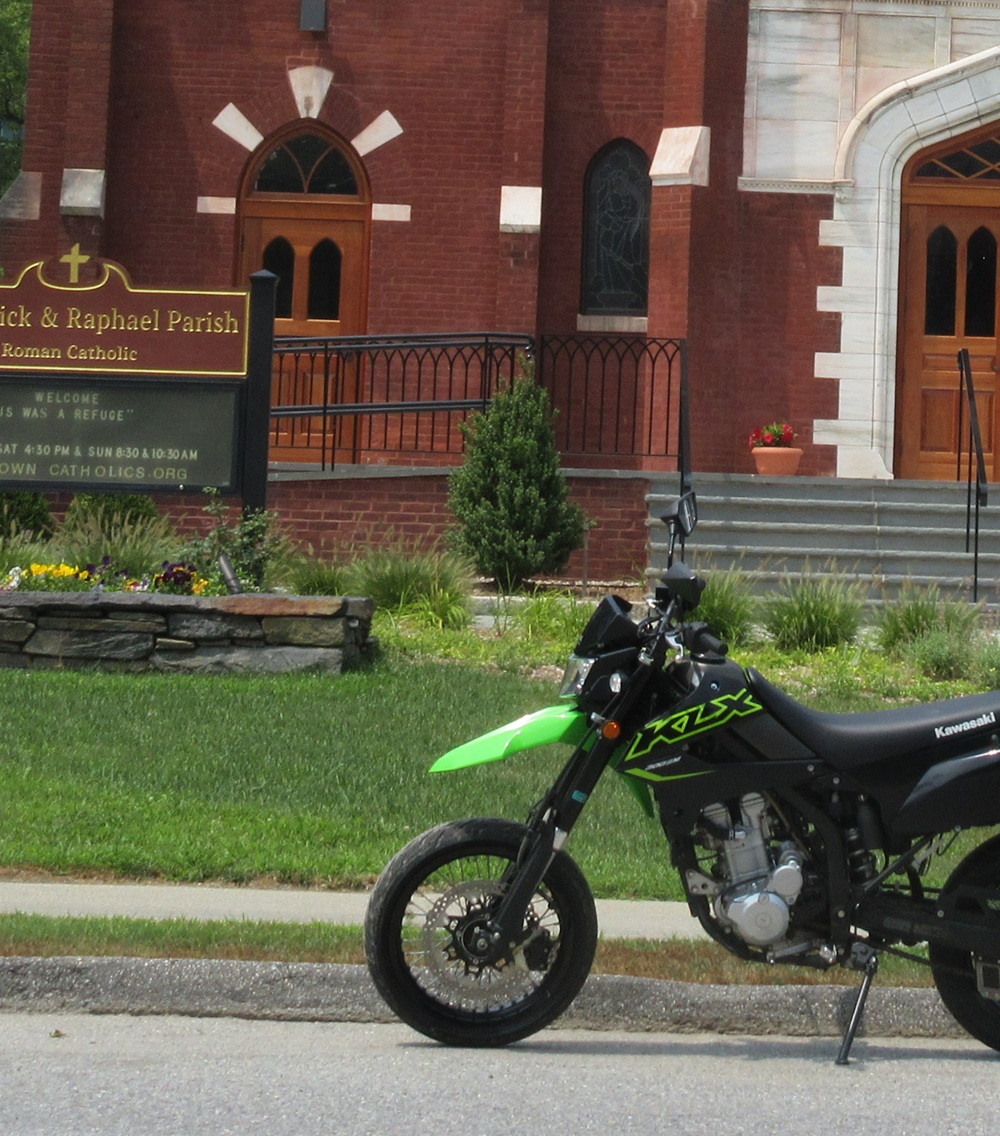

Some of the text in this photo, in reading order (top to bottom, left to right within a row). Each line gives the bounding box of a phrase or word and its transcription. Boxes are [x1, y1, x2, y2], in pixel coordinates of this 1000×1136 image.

[0, 305, 239, 335] ick & Raphael Parish
[1, 343, 138, 361] Roman Catholic
[35, 392, 100, 405] WELCOME
[22, 407, 48, 419] WAS
[57, 408, 65, 420] A
[24, 444, 51, 456] 4:30
[54, 445, 70, 457] PM
[74, 446, 82, 457] &
[88, 446, 113, 458] SUN
[115, 447, 140, 459] 8:30
[142, 448, 150, 459] &
[624, 688, 764, 762] KLX
[934, 711, 996, 739] Kawasaki
